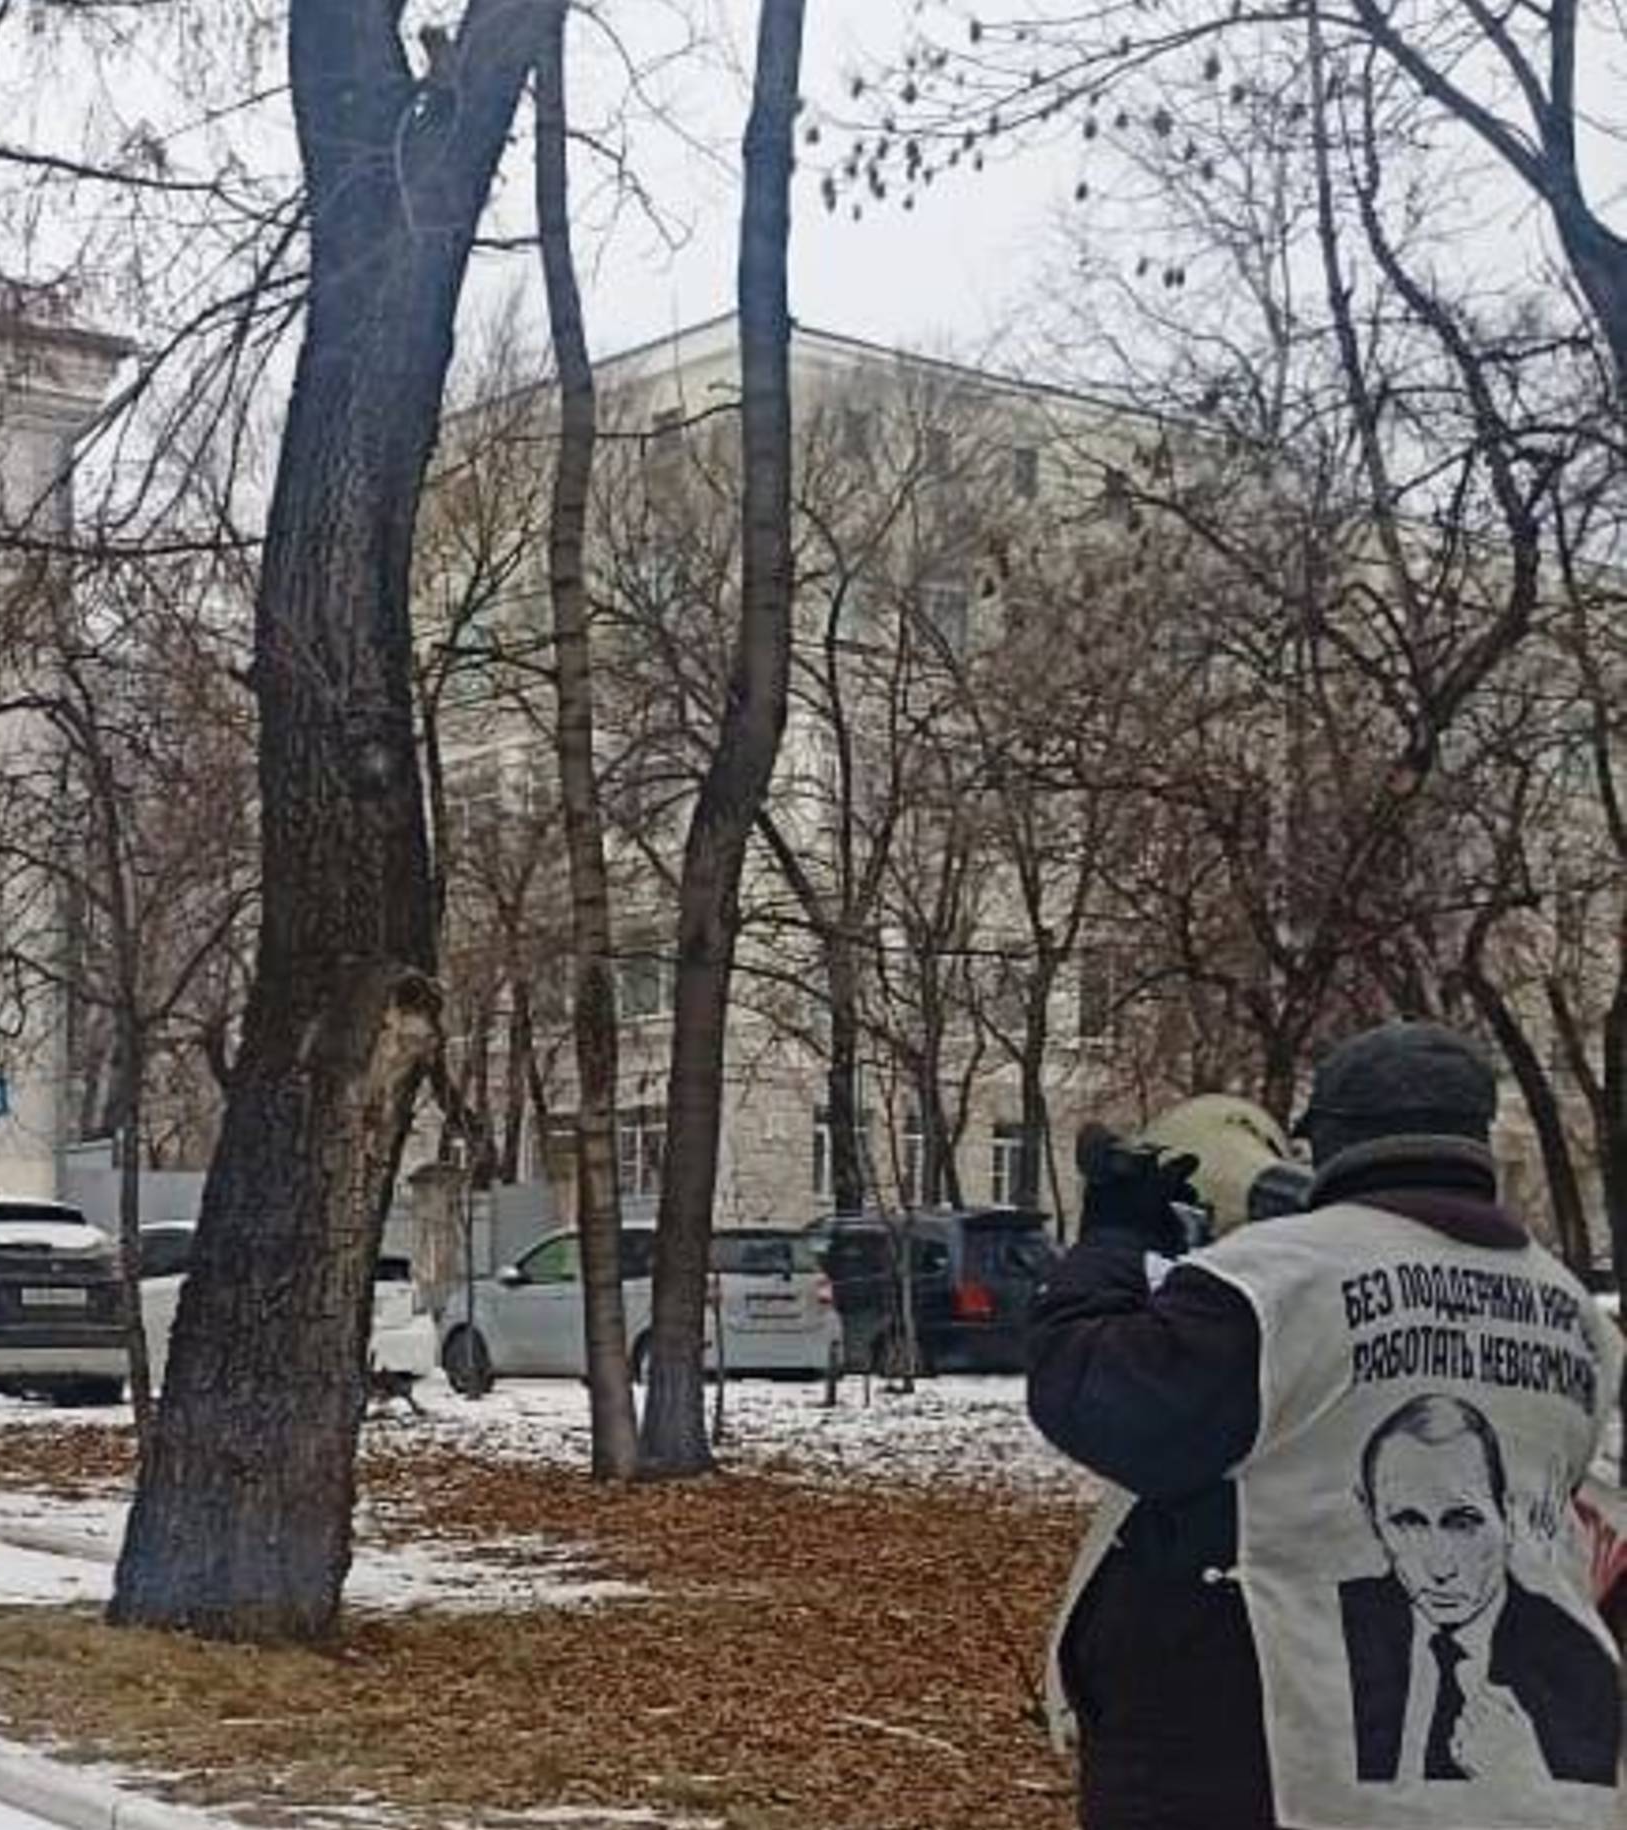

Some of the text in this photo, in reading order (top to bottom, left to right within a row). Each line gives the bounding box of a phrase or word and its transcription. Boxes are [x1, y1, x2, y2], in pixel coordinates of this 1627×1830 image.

[1342, 1269, 1393, 1329] БЕЗ
[1397, 1264, 1537, 1325] ПОДДЕРЖКИ
[1353, 1326, 1473, 1386] РАБОТАТЬ
